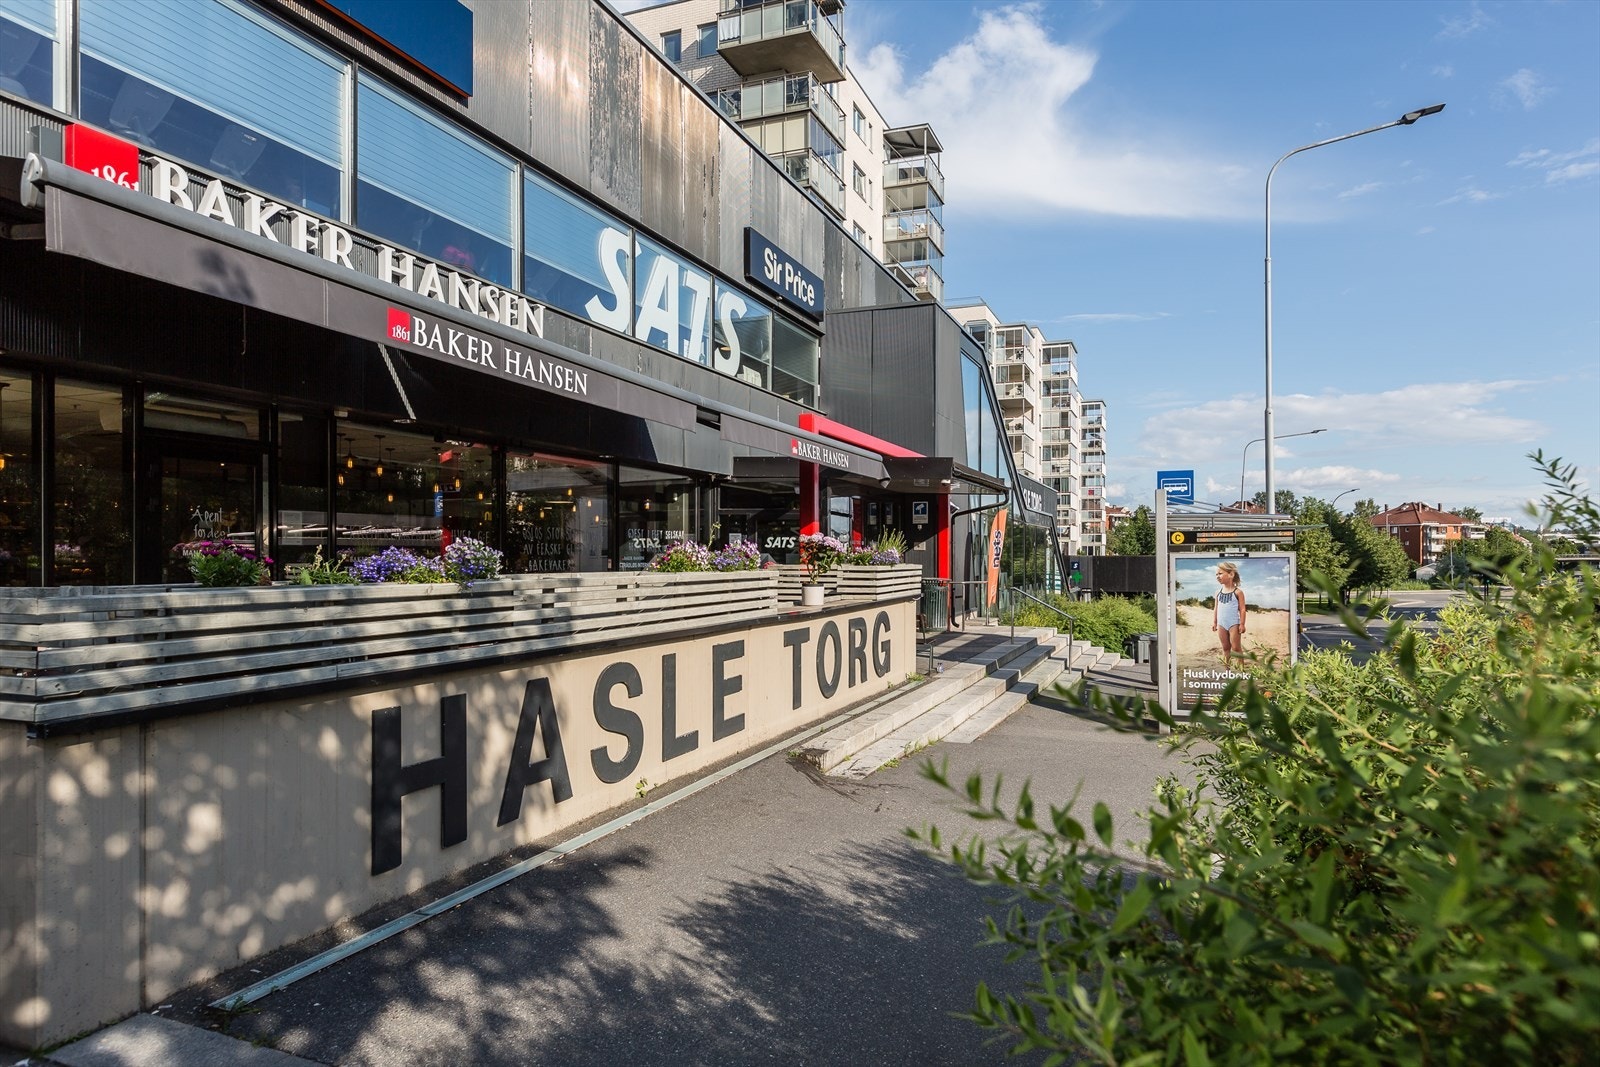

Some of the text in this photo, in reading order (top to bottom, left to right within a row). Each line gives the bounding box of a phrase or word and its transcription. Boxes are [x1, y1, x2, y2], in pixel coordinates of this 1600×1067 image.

[146, 156, 546, 338] BAKER HANSEN
[763, 247, 815, 307] Sir Price
[584, 227, 748, 377] SATS
[391, 324, 411, 342] 1861
[412, 316, 588, 396] BAKER HANSEN
[797, 441, 849, 468] BAKER HANSEN
[765, 537, 797, 548] SATS
[993, 530, 1002, 569] nets
[1183, 669, 1210, 679] Husk
[1183, 679, 1230, 689] i somme
[371, 611, 891, 876] HASLE TORG
